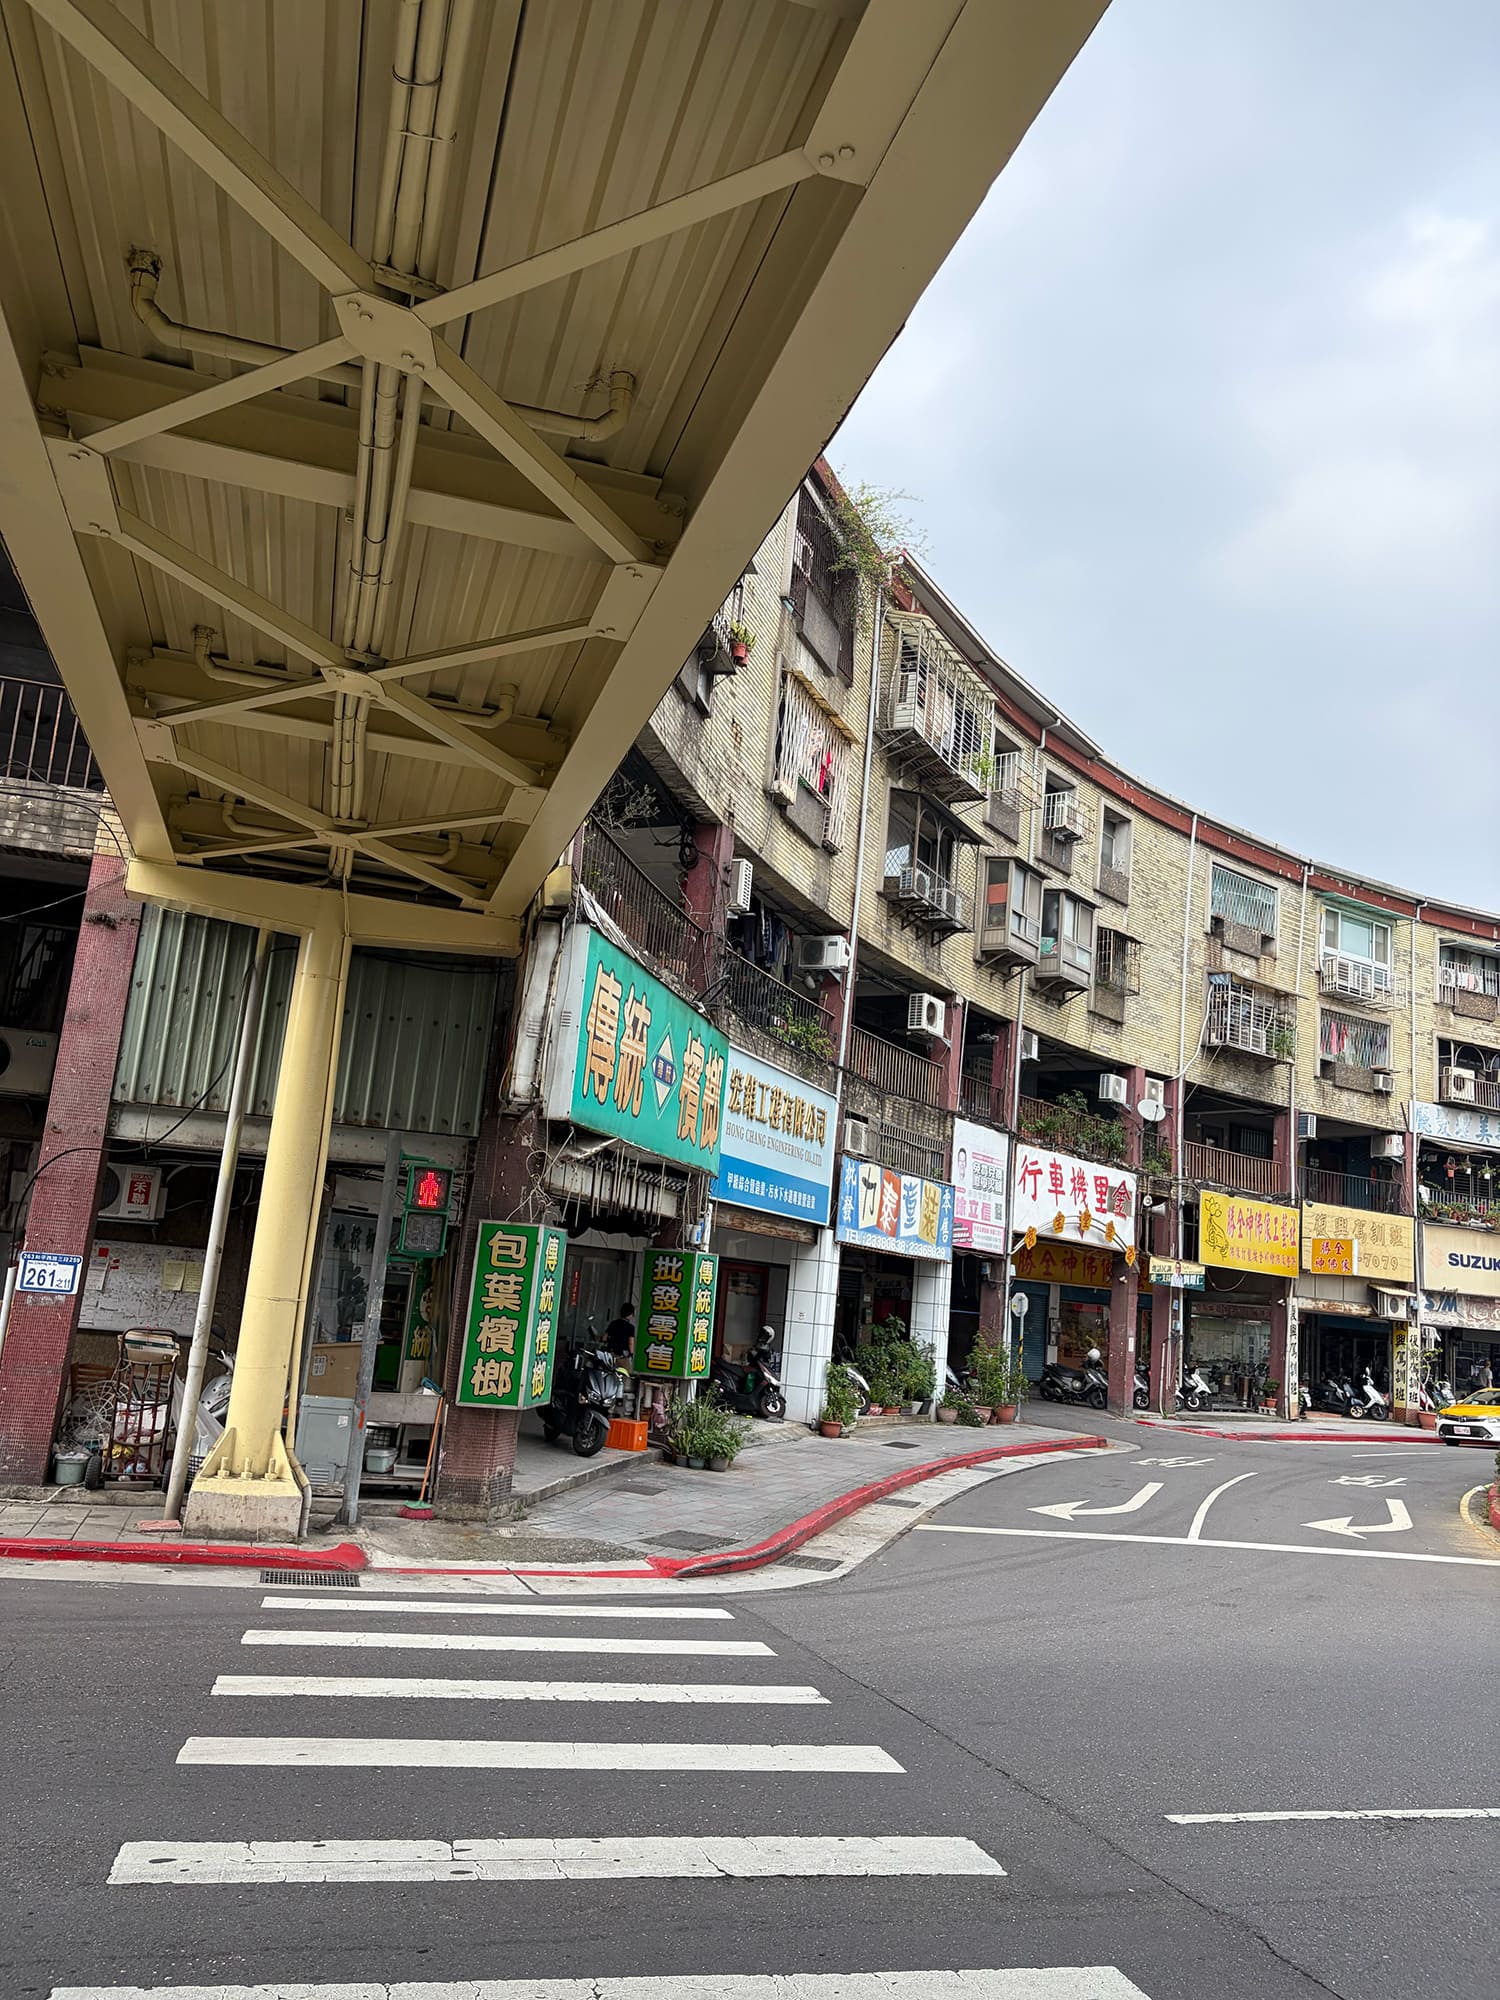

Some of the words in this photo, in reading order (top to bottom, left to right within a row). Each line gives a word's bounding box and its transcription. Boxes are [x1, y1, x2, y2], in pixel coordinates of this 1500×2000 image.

[583, 960, 651, 1118] 傳統
[677, 1027, 724, 1155] 檳榔
[725, 1121, 744, 1140] HONG
[745, 1129, 766, 1147] CHANG
[767, 1136, 804, 1161] ENGINEERING
[471, 1230, 528, 1399] 包葉檳榔
[531, 1234, 560, 1399] 傳統檳榔
[645, 1255, 683, 1371] 批發零售
[690, 1259, 714, 1373] 傳統檳榔
